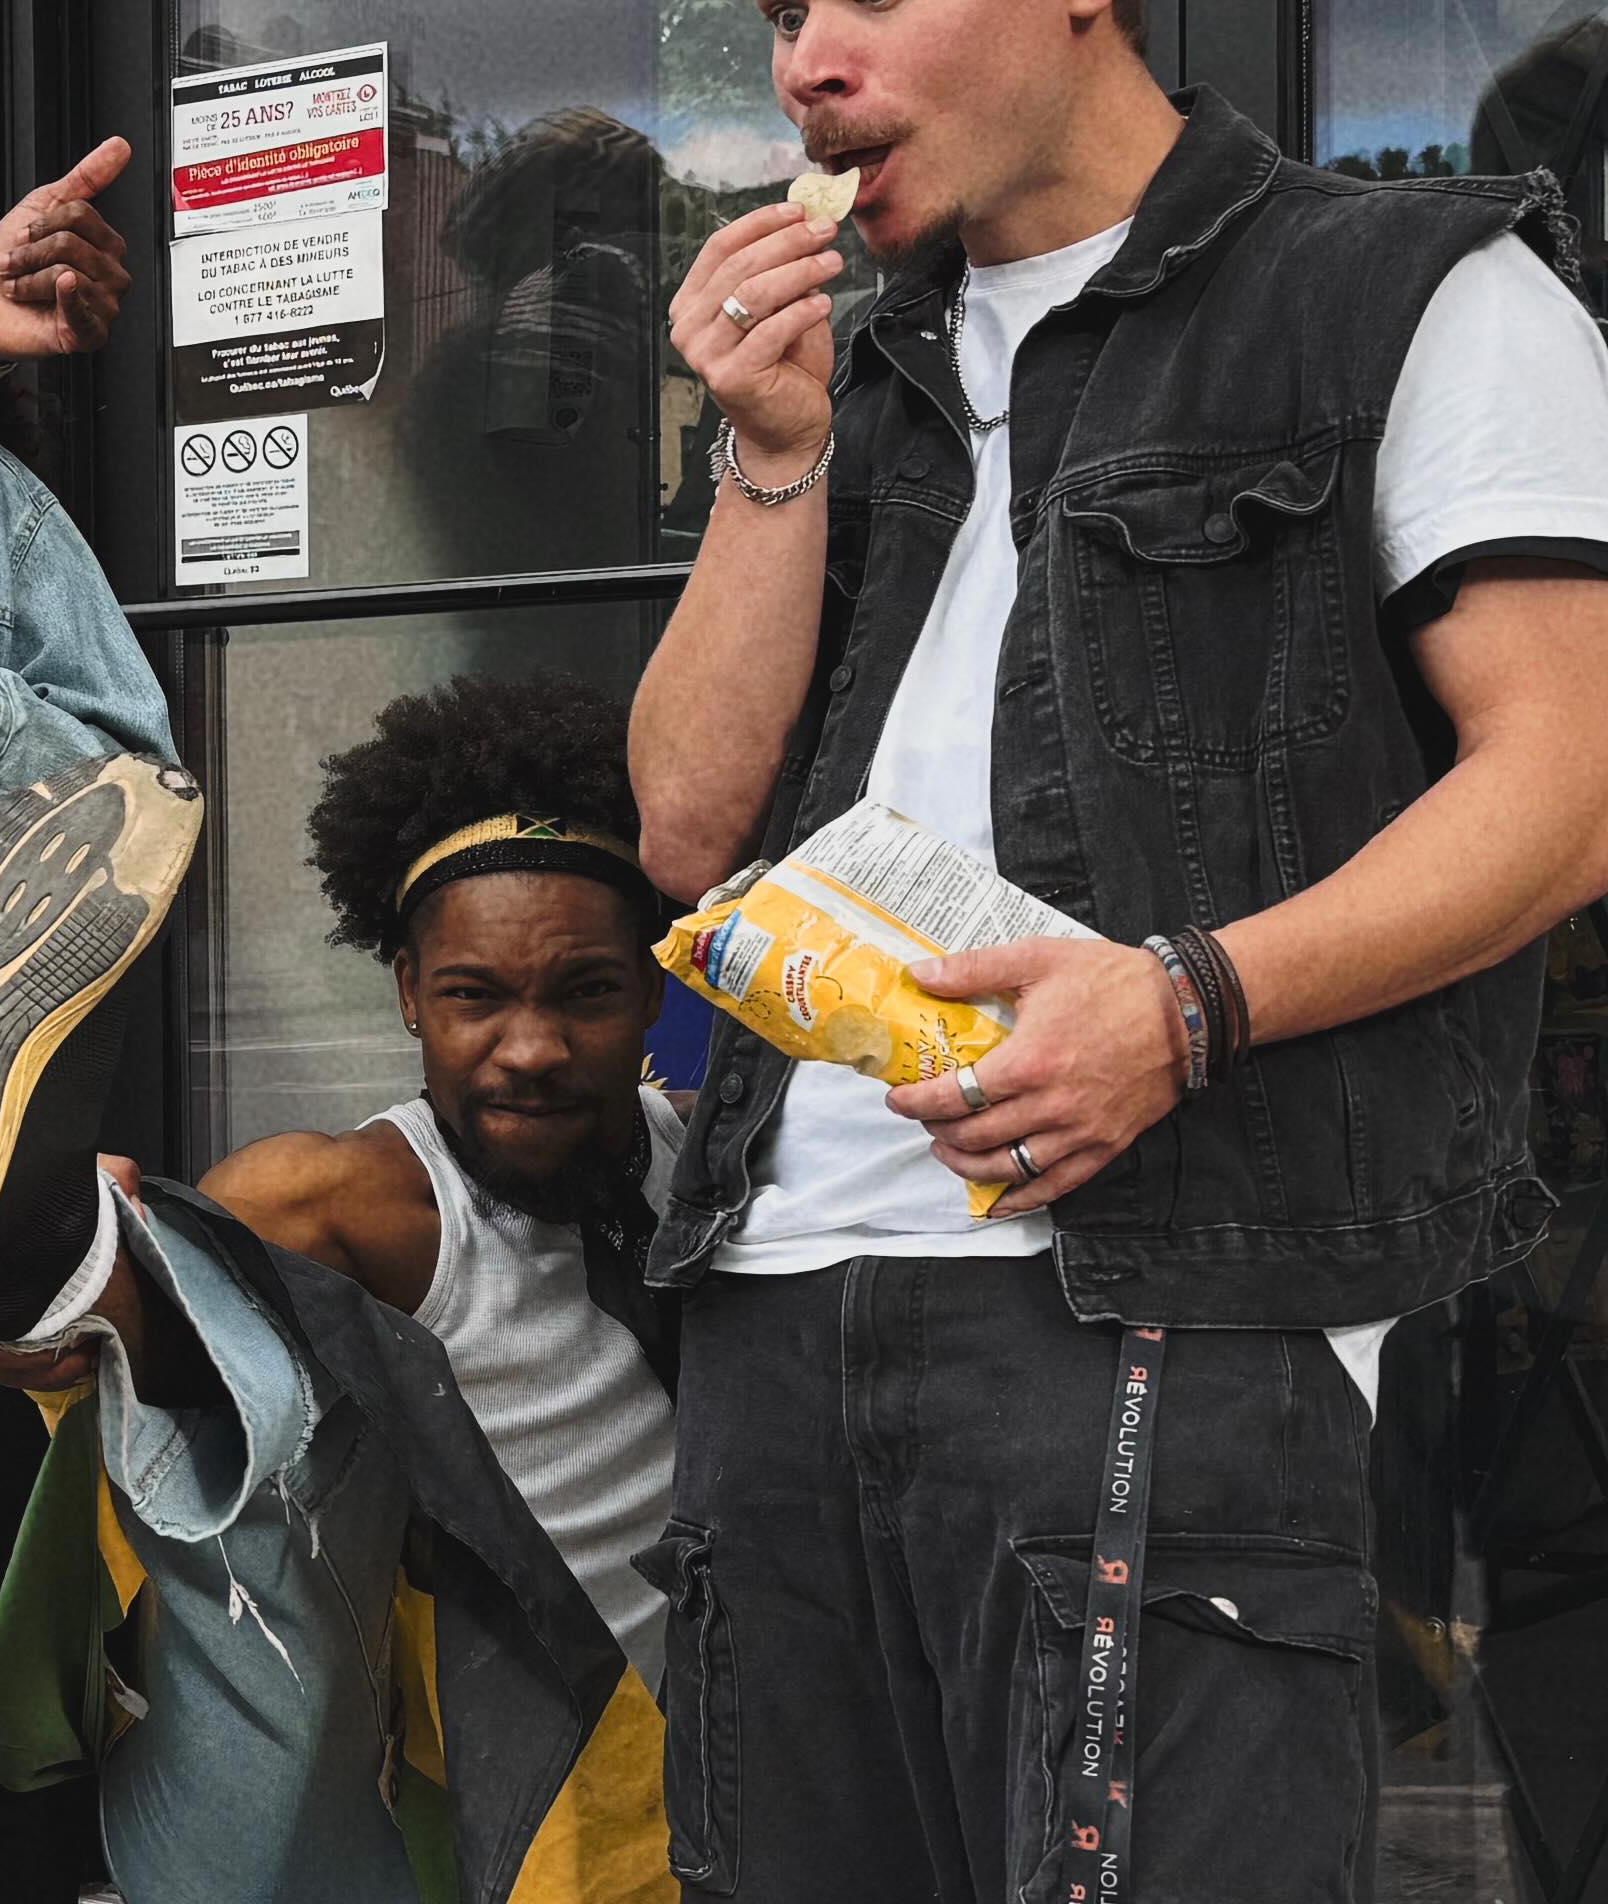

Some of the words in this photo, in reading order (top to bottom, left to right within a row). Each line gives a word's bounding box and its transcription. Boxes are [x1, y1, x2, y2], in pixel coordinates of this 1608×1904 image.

[218, 81, 248, 94] TABAC
[299, 67, 336, 81] ALCOOL
[220, 110, 241, 129] 25
[245, 101, 294, 126] ANS?
[225, 150, 287, 175] d'identité
[289, 136, 360, 161] obligatoire
[201, 241, 280, 264] INTERDICTION
[284, 239, 298, 251] DE
[302, 232, 349, 248] VENDRE
[201, 268, 217, 279] DU
[220, 261, 255, 275] TABAC
[270, 255, 293, 267] DES
[297, 246, 349, 265] MINEURS
[198, 290, 216, 302] LOI
[218, 277, 297, 298] CONCERNANT
[301, 274, 313, 285] LA
[316, 268, 354, 283] LUTTE
[209, 298, 253, 314] CONTRE
[258, 295, 273, 306] LE
[276, 285, 340, 304] TABAGISME
[785, 965, 796, 1004] CRISPY
